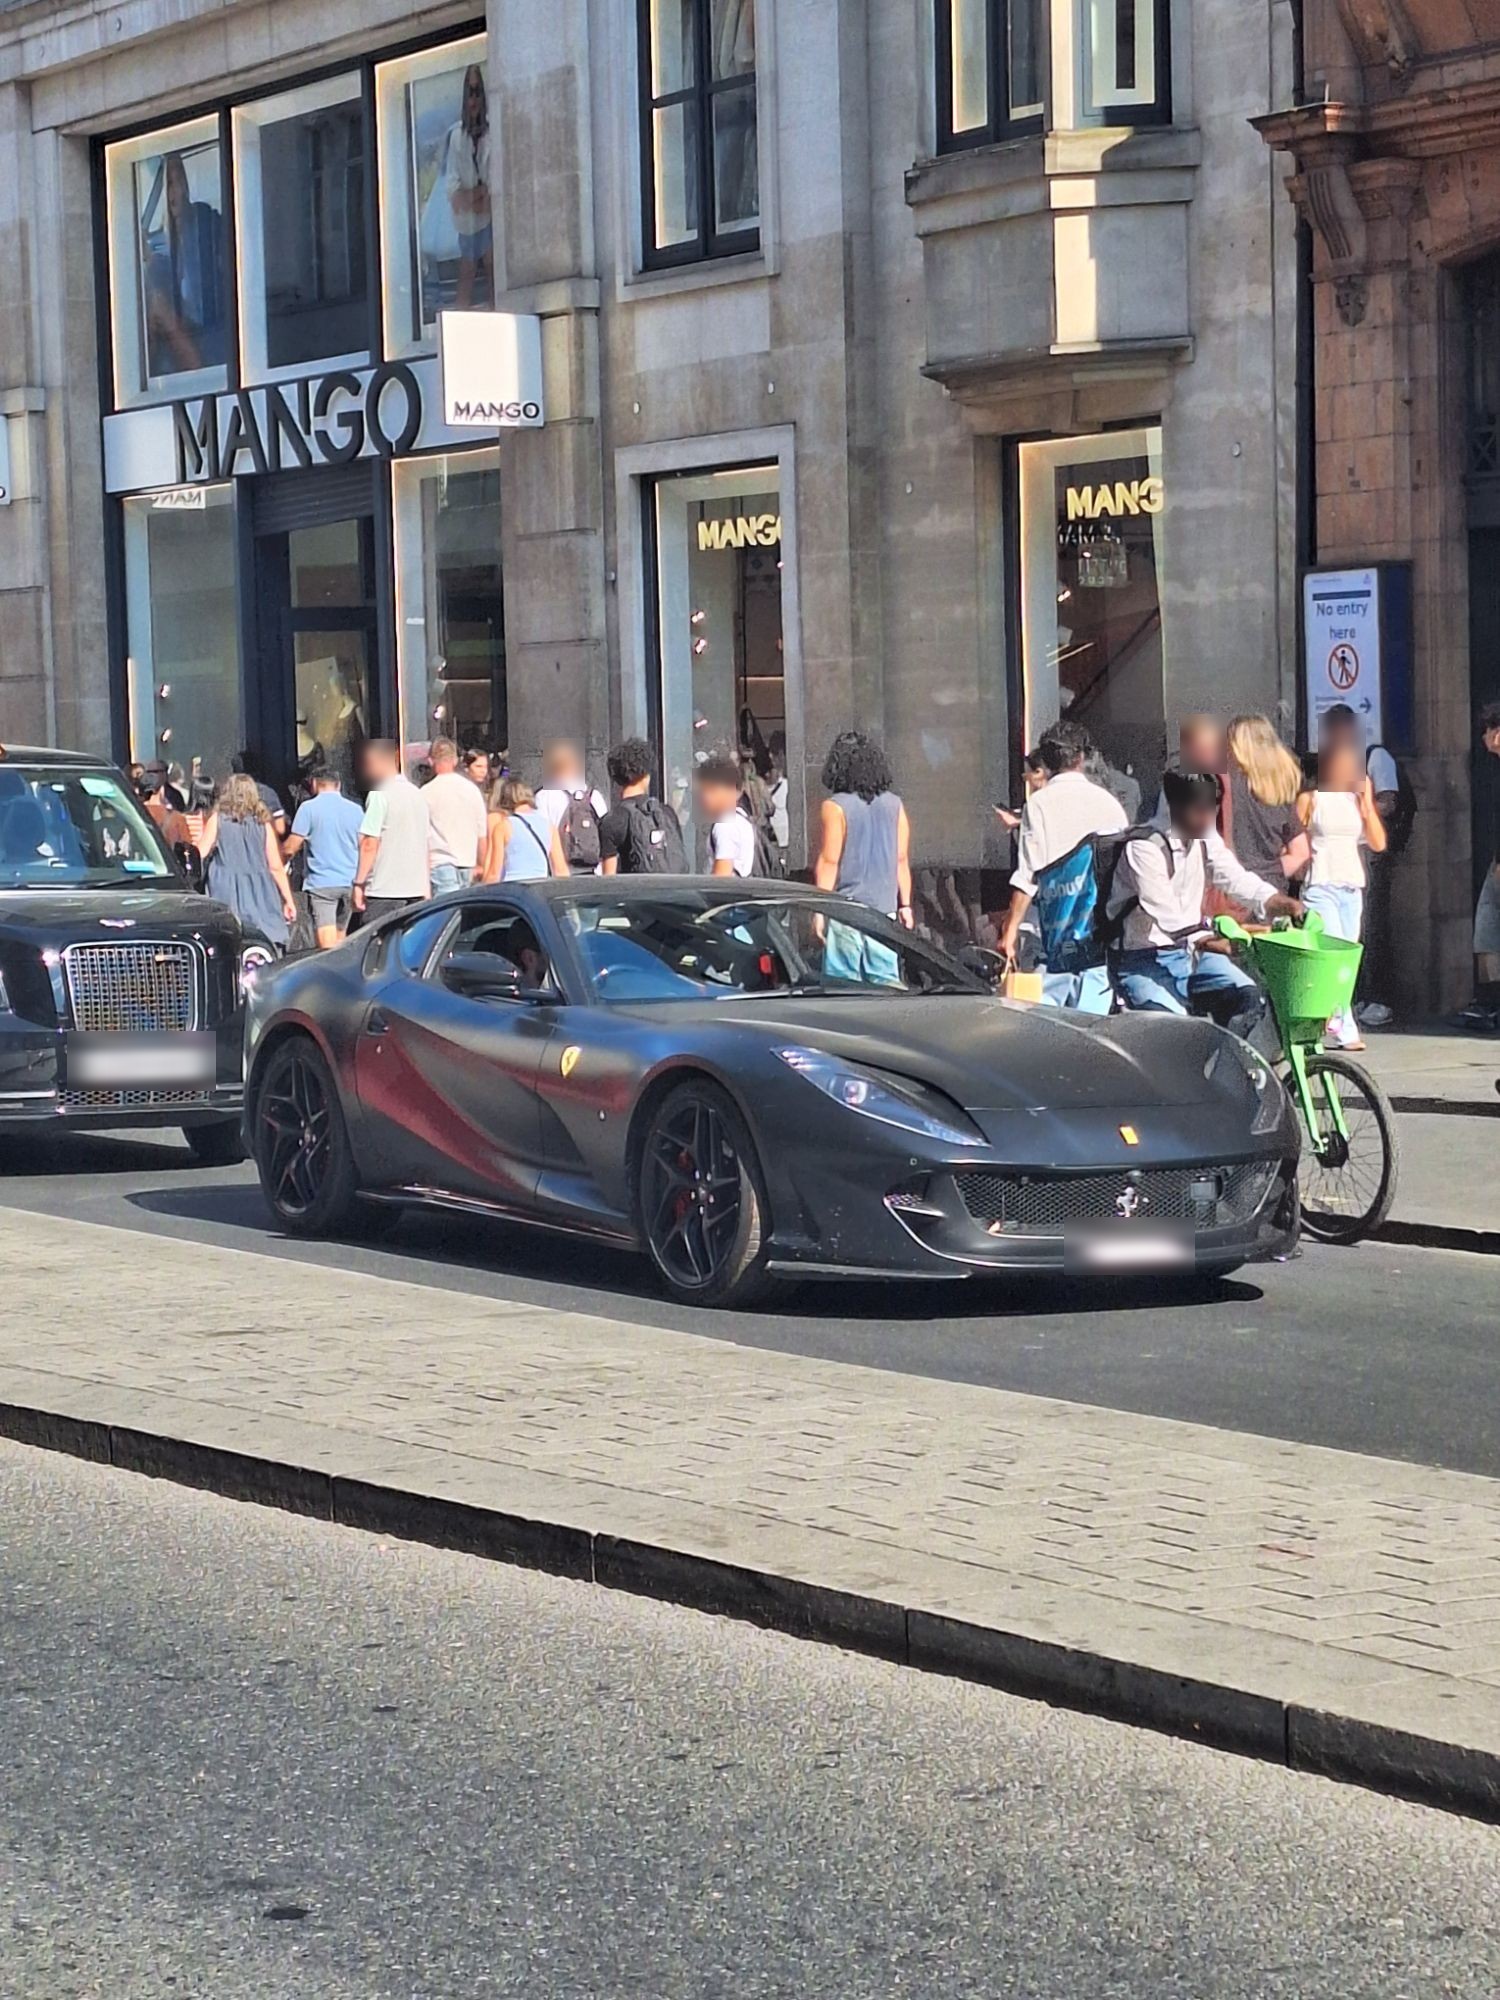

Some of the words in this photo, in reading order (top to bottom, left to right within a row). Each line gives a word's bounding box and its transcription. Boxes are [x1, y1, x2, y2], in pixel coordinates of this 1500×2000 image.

[453, 401, 540, 420] MANGO
[173, 362, 422, 484] MANGO
[1316, 603, 1333, 616] No
[1337, 602, 1368, 617] entry
[1329, 626, 1356, 639] here
